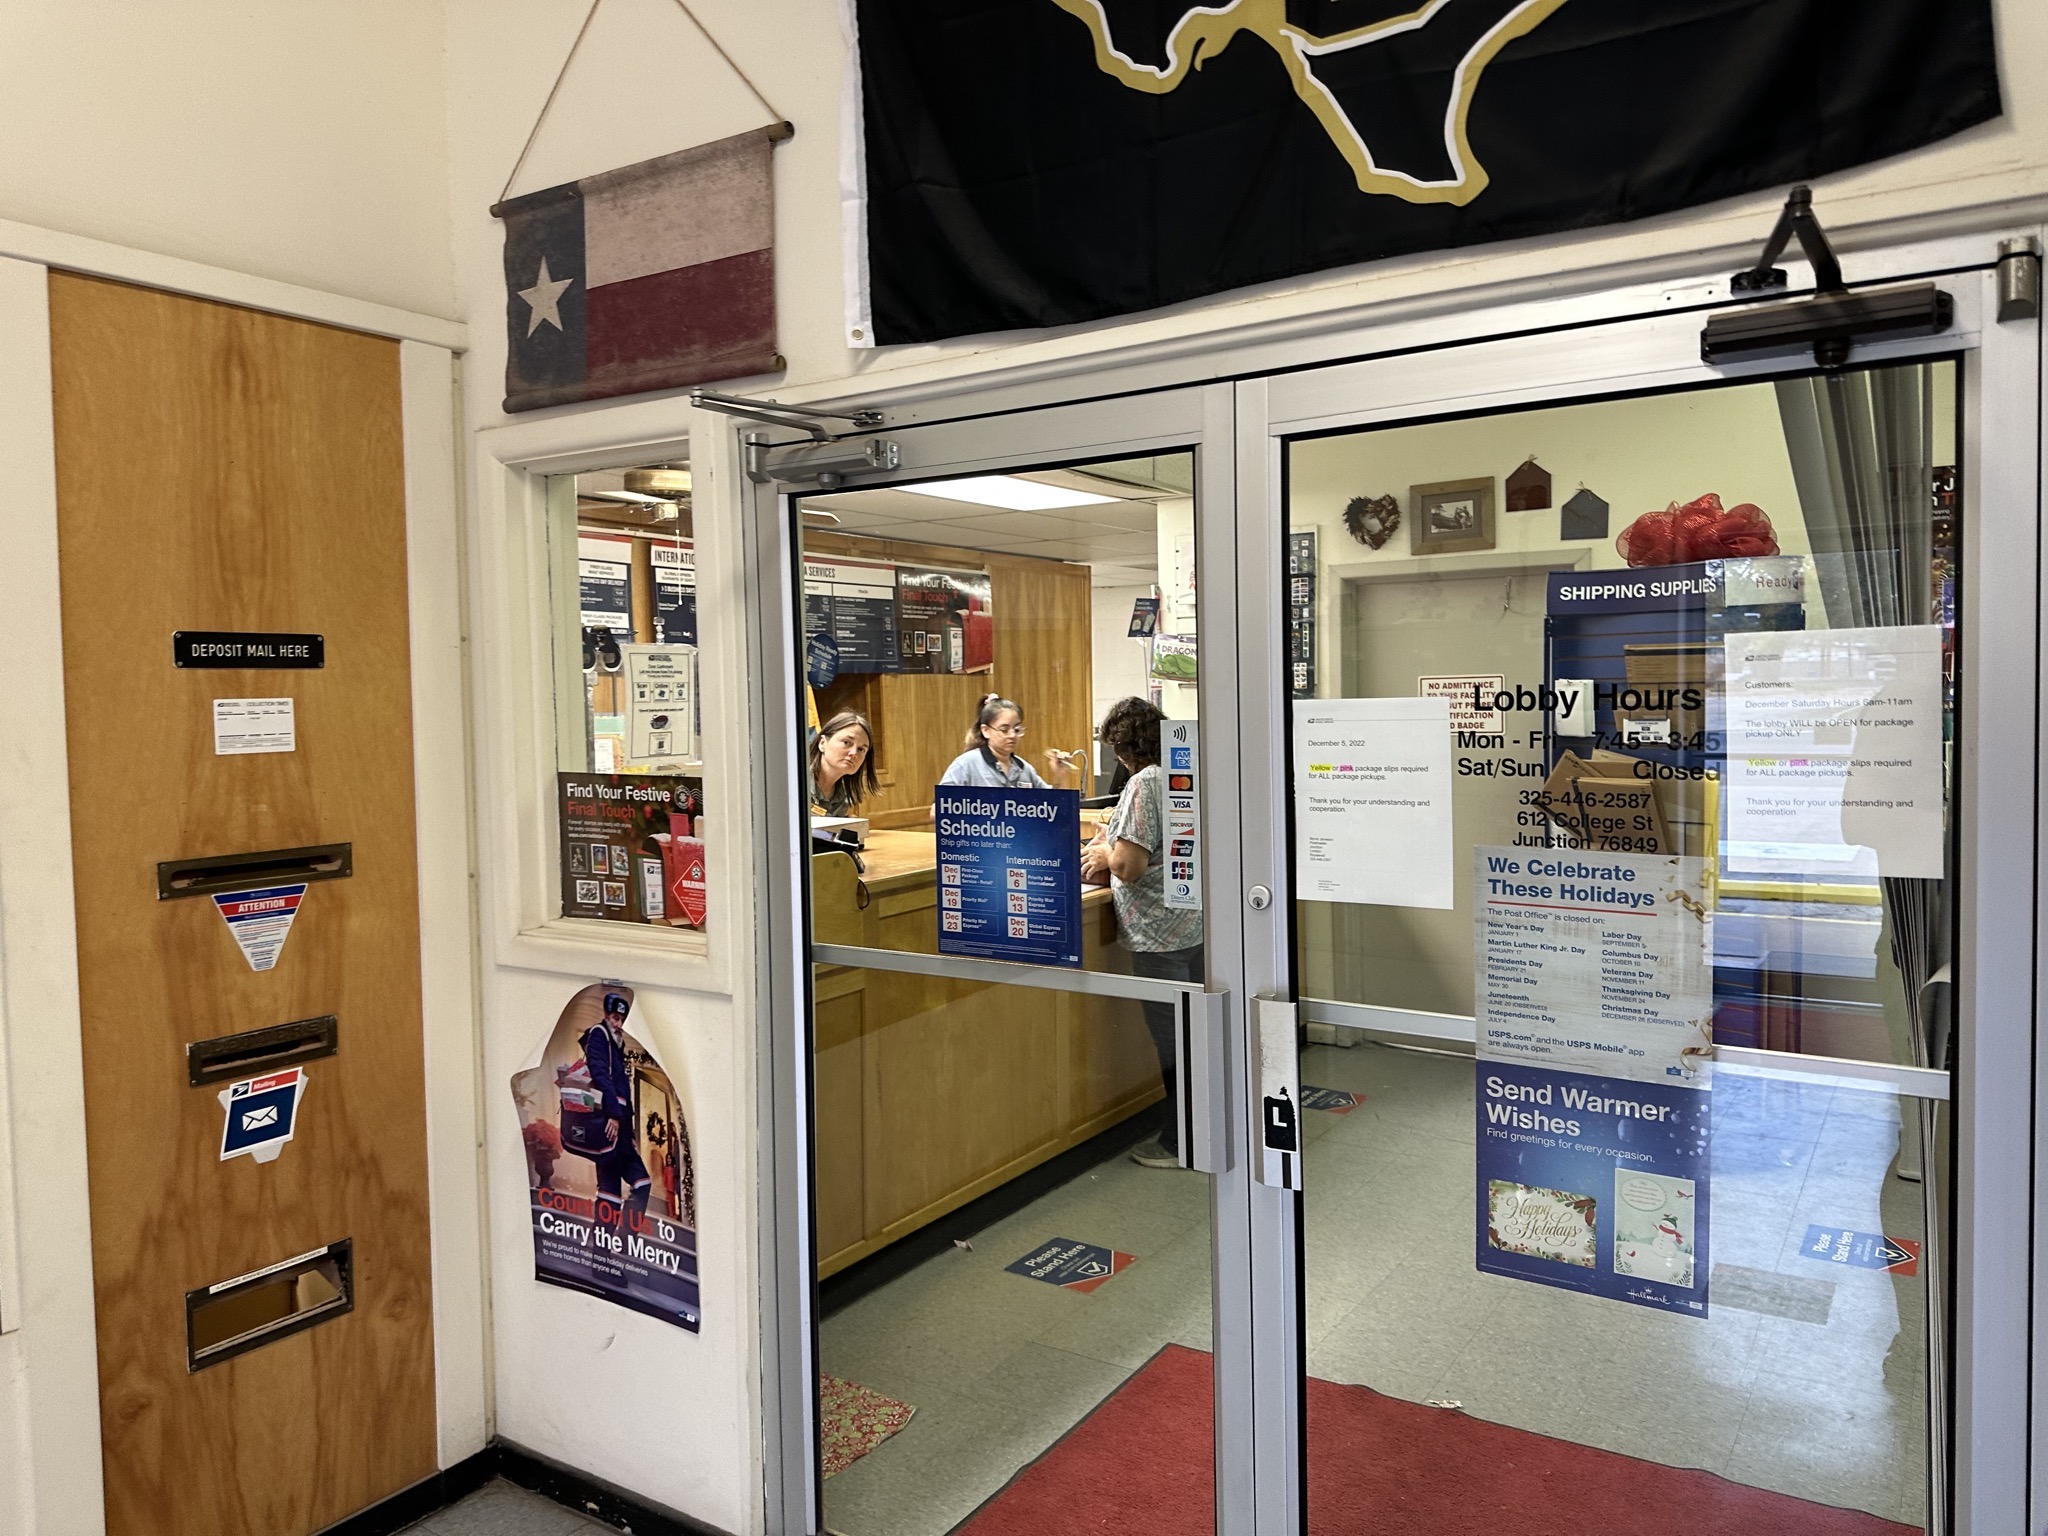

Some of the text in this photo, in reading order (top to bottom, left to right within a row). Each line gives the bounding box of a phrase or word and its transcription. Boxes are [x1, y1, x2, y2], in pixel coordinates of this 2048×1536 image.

[809, 567, 835, 579] SERVICES
[1560, 578, 1716, 601] SHIPPING SUPPLIES
[192, 644, 310, 657] DEPOSIT MAIL HERE
[1442, 681, 1494, 689] ADMITTANCE
[1745, 681, 1793, 689] Customers:
[1474, 683, 1701, 718] Lobby Hours
[1791, 699, 1830, 708] Saturday
[1834, 699, 1860, 707] Hours
[1863, 698, 1912, 706] 6am-11am
[1764, 720, 1786, 729] lobby
[1829, 719, 1857, 727] OPEN
[1874, 719, 1913, 728] package
[1745, 729, 1801, 738] pickup ONLY
[1458, 731, 1504, 749] Mon
[1529, 731, 1557, 750] Fri
[1593, 732, 1641, 750] 7:45
[1667, 732, 1721, 751] 3:45
[1175, 751, 1190, 759] AM
[1178, 758, 1190, 766] EX
[1457, 757, 1721, 781] Sat/Sun Closed
[566, 783, 670, 802] Find Your Festive
[1369, 799, 1415, 807] understanding
[1519, 790, 1652, 809] 325-446-2587
[567, 801, 636, 818] Final Touch
[940, 798, 1058, 822] Holiday Ready
[1517, 811, 1653, 832] 612 College St
[940, 819, 1016, 838] Schedule
[941, 838, 955, 847] Ship
[956, 840, 970, 848] gifts
[981, 841, 994, 849] later
[1513, 832, 1658, 852] Junction 76849
[941, 852, 980, 862] Domestic
[944, 866, 958, 874] Dec
[1009, 870, 1024, 878] Dec
[1488, 857, 1636, 882] We Celebrate
[947, 874, 956, 883] 17
[1014, 879, 1020, 887] 6
[945, 889, 958, 897] Dec
[1010, 894, 1024, 902] Dec
[1488, 878, 1655, 909] These Holidays
[238, 899, 285, 913] ATTENTION
[947, 898, 957, 907] 19
[1012, 903, 1023, 912] 13
[1010, 917, 1025, 926] Dec
[1488, 908, 1502, 917] The
[1504, 910, 1522, 918] Post
[1554, 913, 1561, 921] is
[1563, 914, 1590, 924] closed
[947, 921, 958, 930] 23
[1012, 927, 1024, 936] 20
[1530, 925, 1544, 933] Day
[1602, 931, 1642, 941] Labor Day
[1488, 939, 1512, 947] Martin
[1514, 941, 1538, 949] Luther
[1540, 944, 1557, 952] King
[1571, 946, 1586, 955] Day
[1488, 956, 1543, 968] Presidents Day
[1602, 949, 1658, 962] Columbus Day
[1602, 967, 1636, 977] Veterans
[1488, 974, 1538, 985] Memorial Day
[1488, 991, 1529, 1001] Juneteenth
[1602, 986, 1671, 1000] Thanksgiving Day
[1488, 1009, 1555, 1023] Independence Day
[1602, 1004, 1659, 1017] Christmas Day
[253, 1080, 276, 1090] Mailing
[1486, 1076, 1671, 1122] Send Warmer
[1486, 1102, 1581, 1138] Wishes
[1487, 1127, 1656, 1163] Find greetings for every occasion.
[538, 1187, 675, 1242] Count On Us to
[1502, 1196, 1552, 1225] Happy
[1504, 1212, 1582, 1247] Holidays
[539, 1212, 680, 1275] Carry the Merry
[1025, 1246, 1062, 1267] Please
[1031, 1257, 1064, 1278] Stand
[1062, 1244, 1086, 1259] Here
[1626, 1288, 1671, 1304] Hallmark
